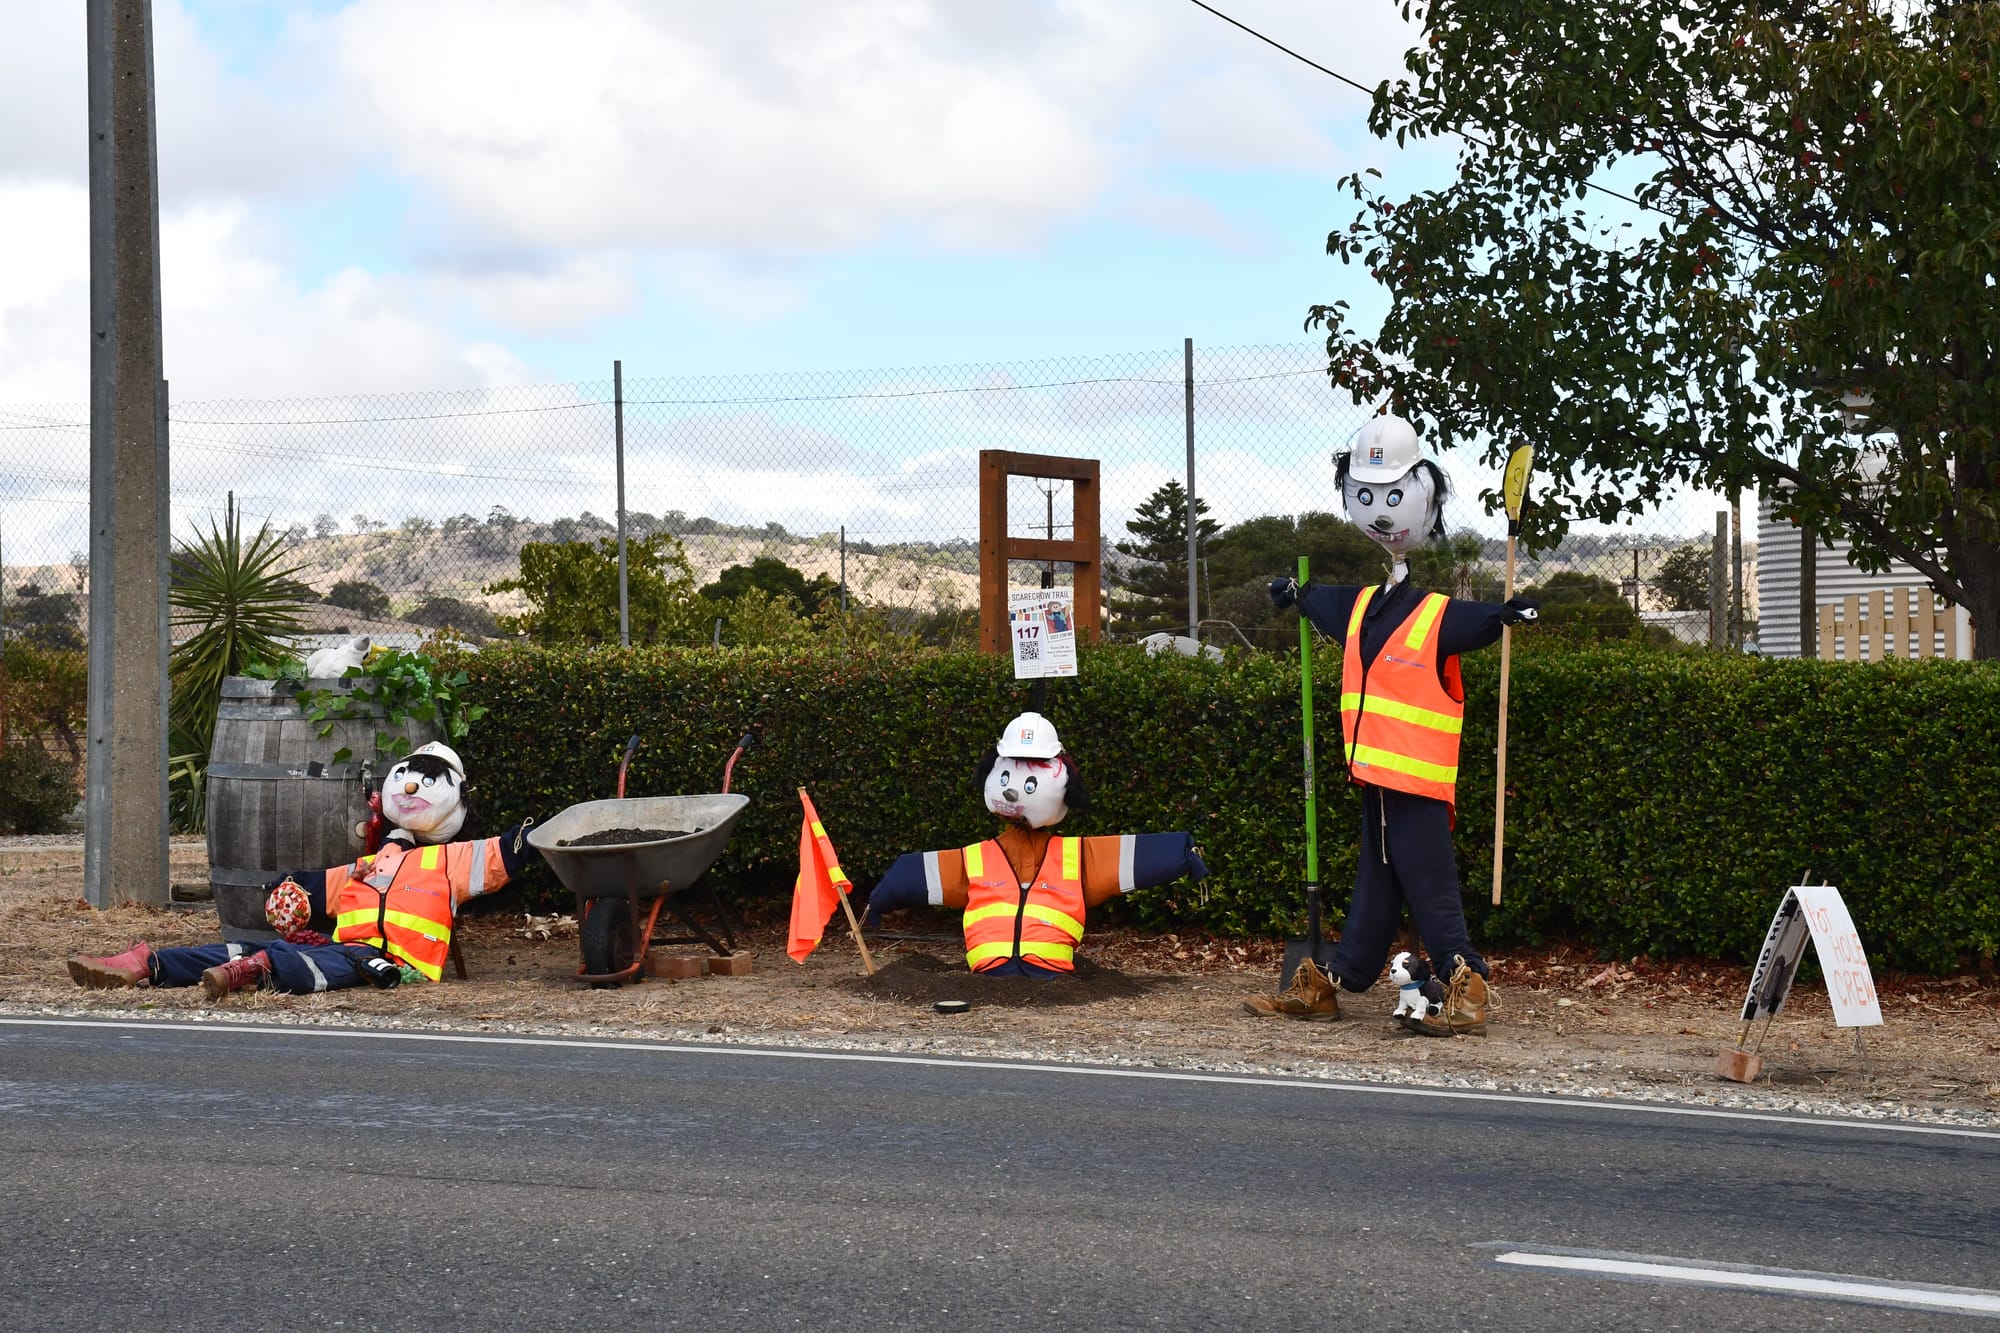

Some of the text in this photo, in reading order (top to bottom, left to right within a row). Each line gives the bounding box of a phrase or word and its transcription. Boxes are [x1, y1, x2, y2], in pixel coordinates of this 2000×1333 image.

[1012, 591, 1069, 602] SCARECROW TRAIL
[1017, 626, 1039, 639] 117
[1830, 932, 1867, 967] HOLE
[1750, 948, 1771, 1003] DAVID
[1834, 968, 1876, 1006] CREW
